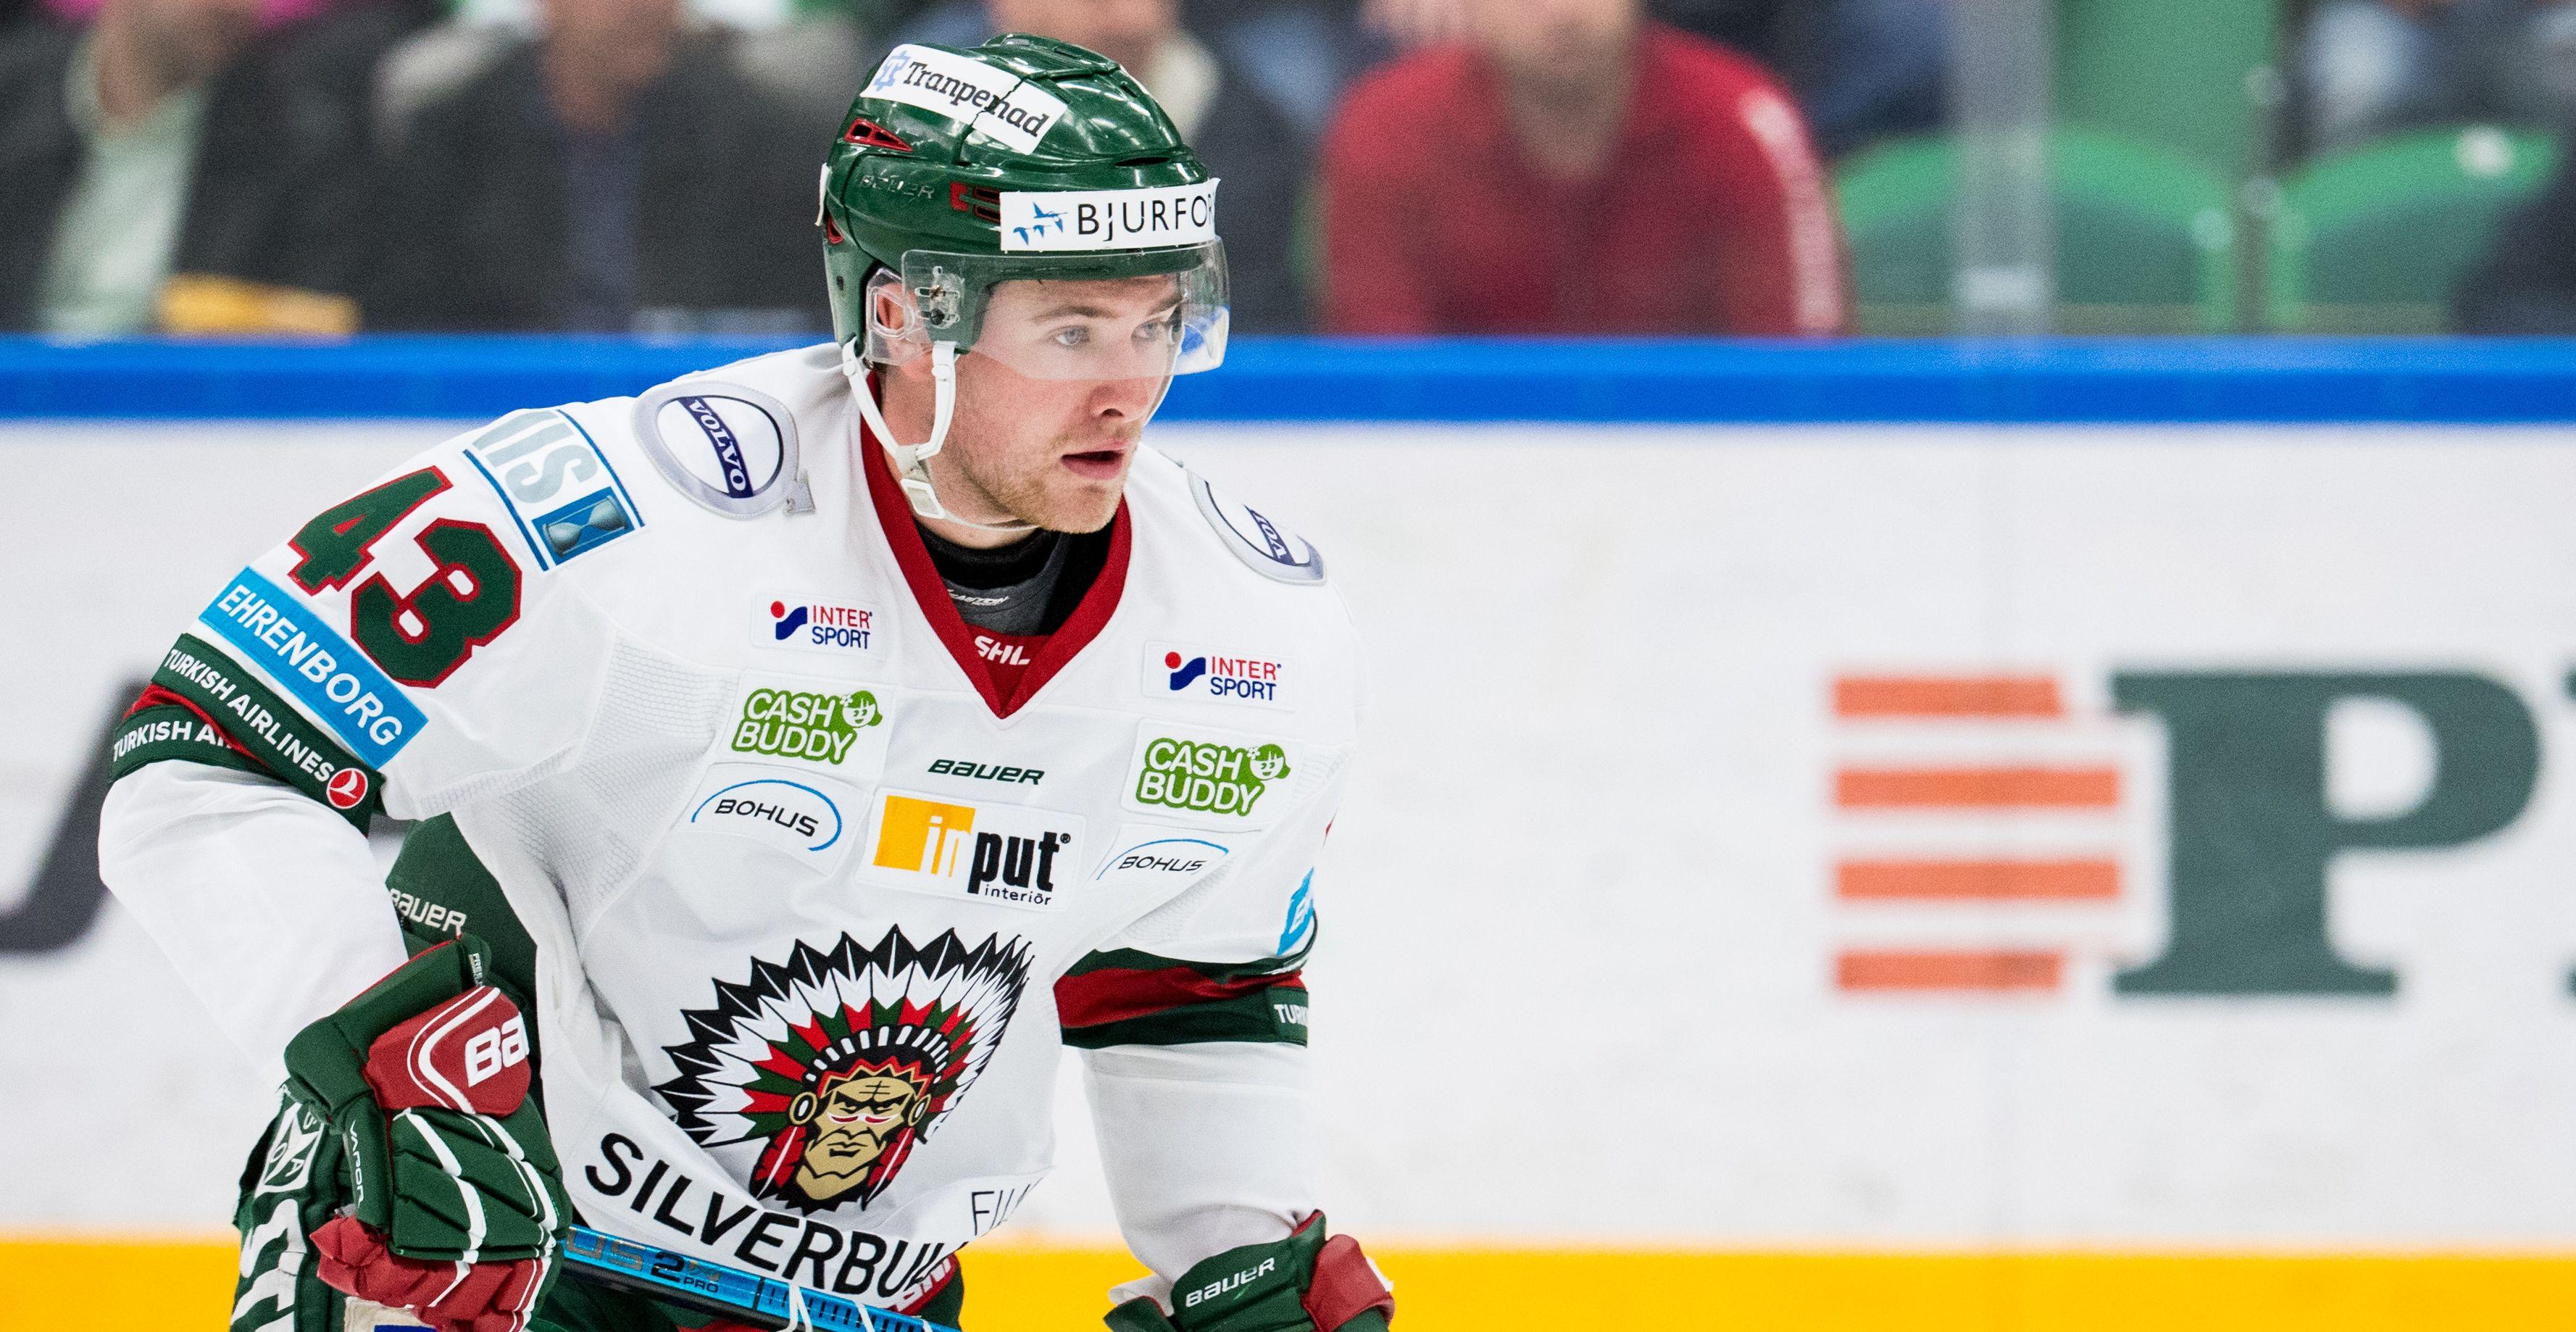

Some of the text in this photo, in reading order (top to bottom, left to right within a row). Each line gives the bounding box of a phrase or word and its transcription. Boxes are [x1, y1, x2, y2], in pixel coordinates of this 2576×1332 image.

[688, 401, 747, 492] VOLVO
[287, 465, 522, 689] 43
[812, 605, 870, 630] INTER
[811, 627, 871, 649] SPORT
[974, 636, 1030, 665] SHL
[217, 584, 403, 748] EHRENBORG
[1211, 656, 1277, 680] INTER
[1209, 677, 1277, 701] SPORT
[164, 649, 335, 783] TURKISH AIRLINES
[747, 693, 836, 728] CASH
[113, 720, 193, 762] TURKISH
[735, 724, 857, 760] BUDDY
[1149, 741, 1244, 781] CASH
[928, 759, 1046, 786] BAUER
[1139, 771, 1262, 814] BUDDY
[714, 798, 820, 838] BOHUS
[2107, 671, 2576, 998] P
[919, 815, 1060, 894] input
[1118, 855, 1206, 873] BOHUS
[985, 883, 1052, 905] interiör
[349, 1119, 364, 1209] VAPOR
[682, 1275, 720, 1294] PRO
[1185, 1257, 1275, 1308] BAUER
